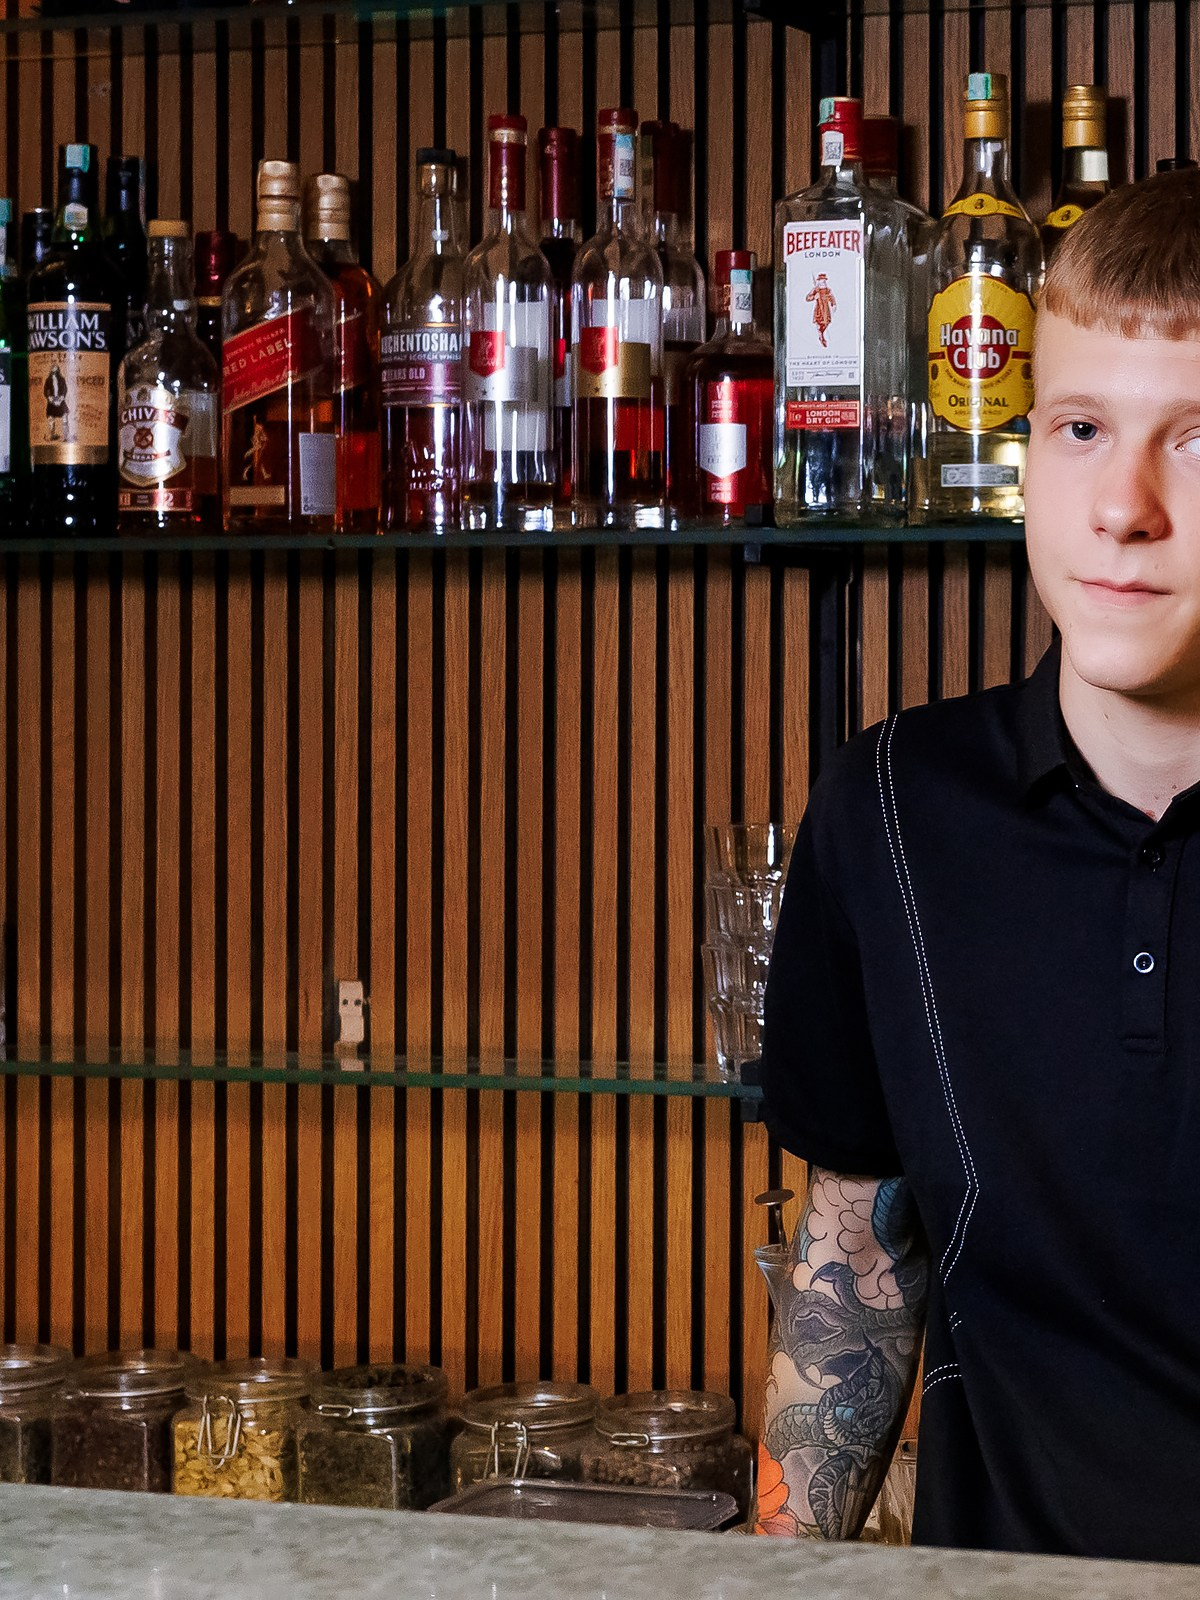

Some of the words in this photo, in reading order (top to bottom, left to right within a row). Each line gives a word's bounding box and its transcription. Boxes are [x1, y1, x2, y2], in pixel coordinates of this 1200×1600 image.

[786, 230, 861, 256] BEEFEATER
[27, 313, 100, 331] WILLIAM
[28, 331, 106, 350] AWSON'S
[939, 322, 1019, 347] Havana
[222, 357, 247, 377] RED
[250, 337, 294, 364] LABEL
[953, 347, 1001, 371] Club
[806, 417, 821, 425] DRY
